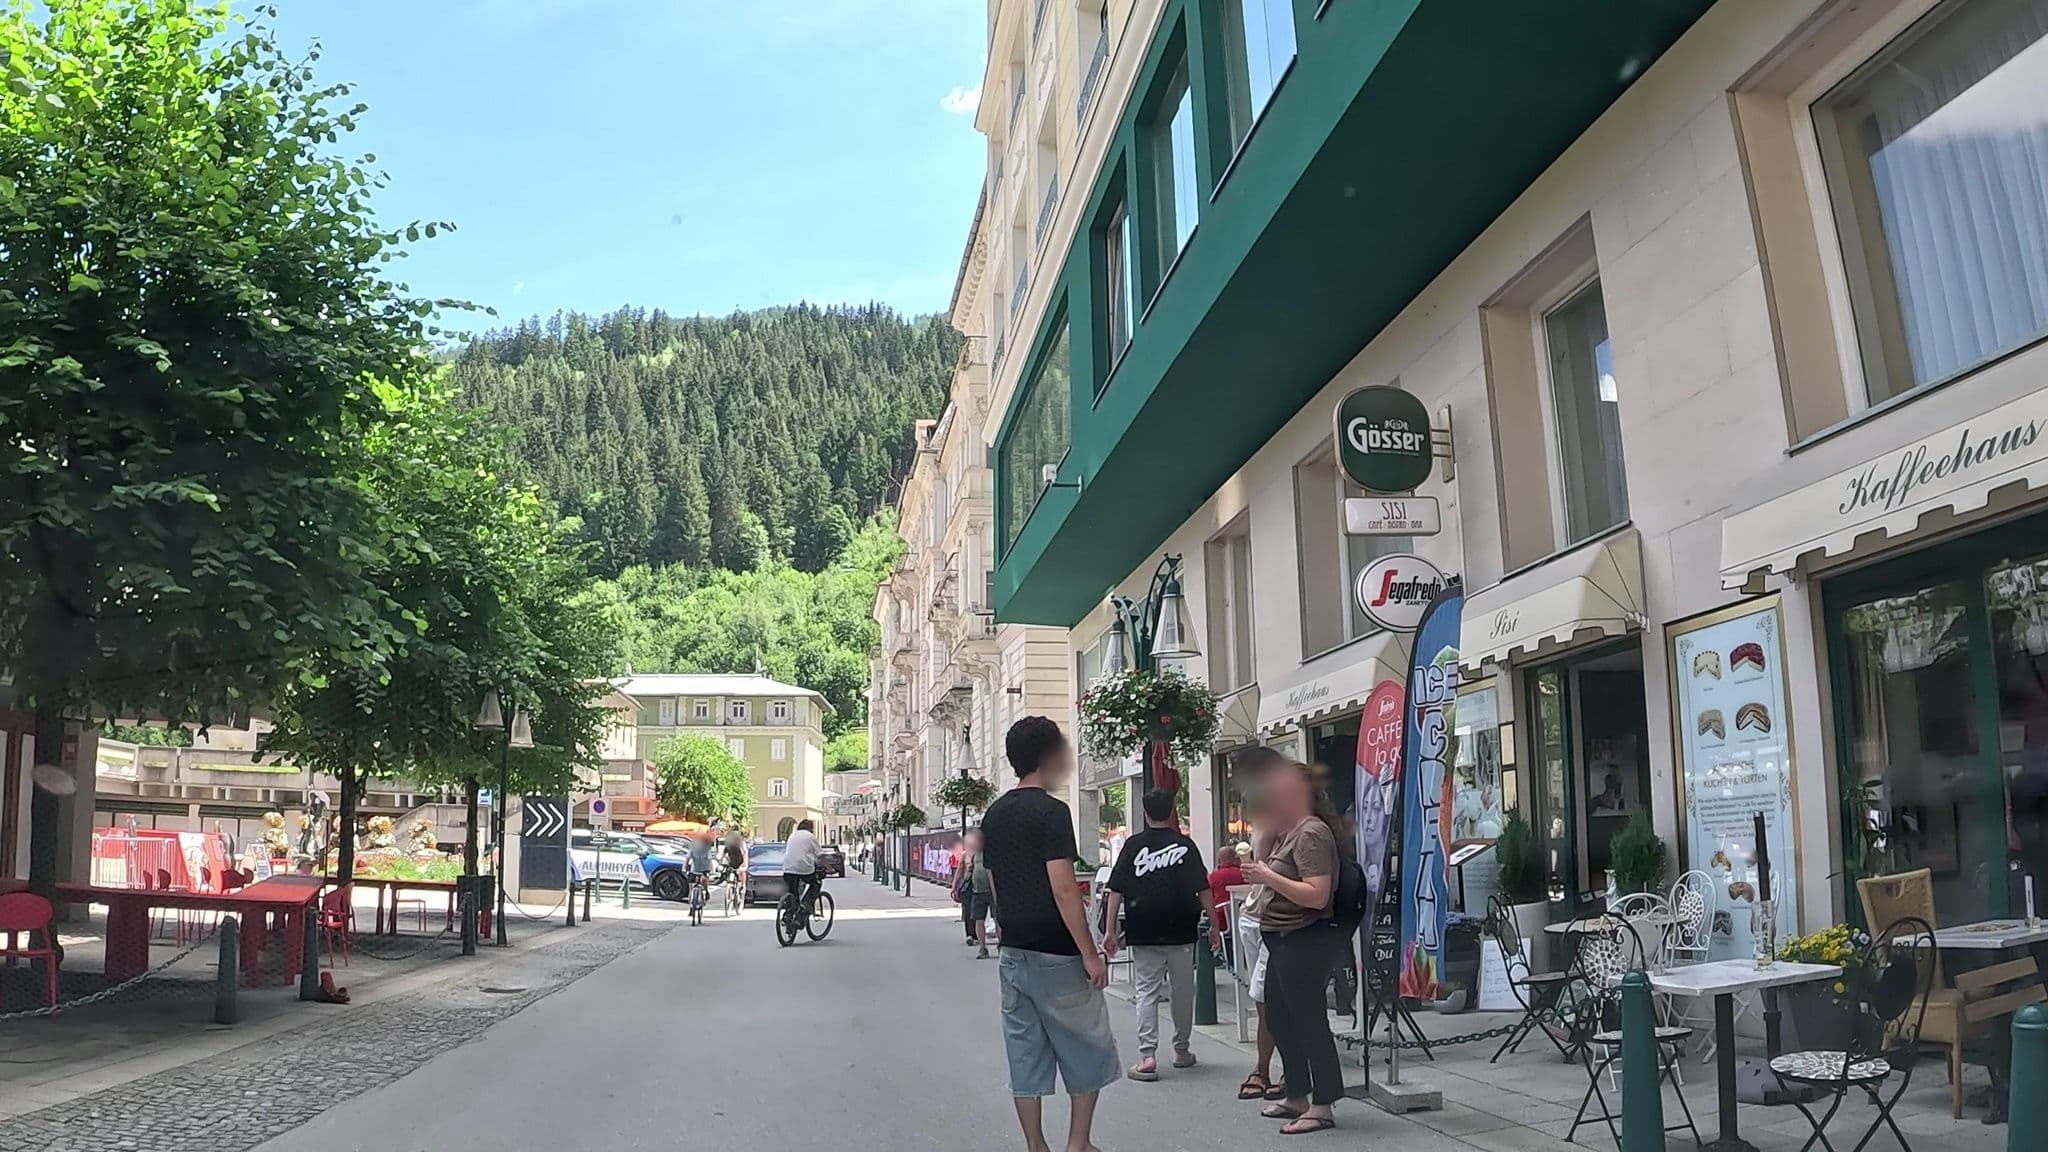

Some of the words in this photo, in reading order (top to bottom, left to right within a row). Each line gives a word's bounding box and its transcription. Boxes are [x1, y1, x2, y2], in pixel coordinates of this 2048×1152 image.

[1347, 417, 1424, 453] Gösser
[1839, 419, 2047, 514] Kaffeehaus
[1381, 502, 1407, 520] SISI
[1490, 609, 1519, 640] Sisi
[1414, 662, 1458, 706] ICE
[582, 860, 641, 874] ALINHYRA
